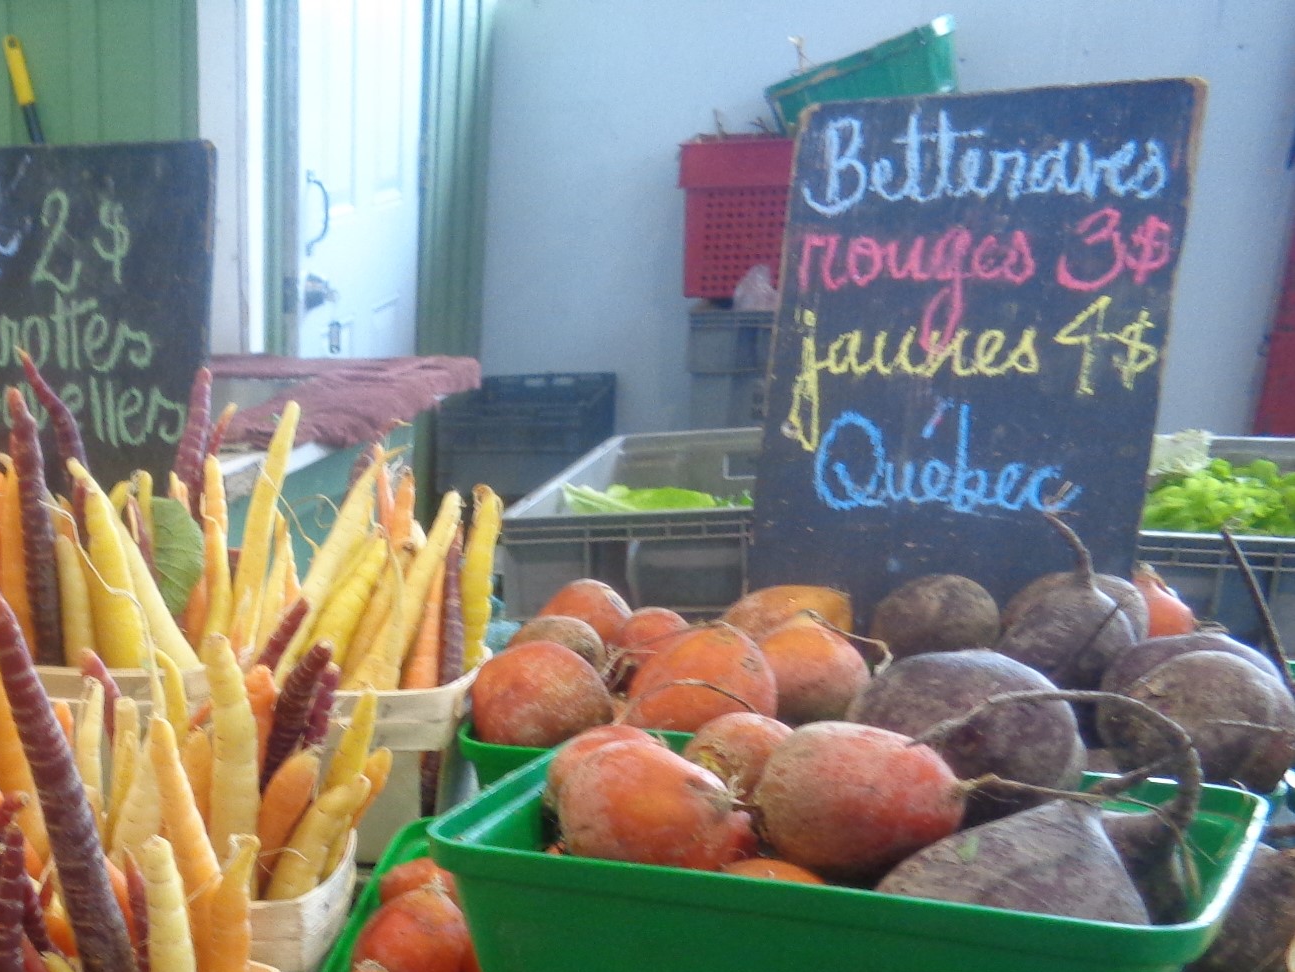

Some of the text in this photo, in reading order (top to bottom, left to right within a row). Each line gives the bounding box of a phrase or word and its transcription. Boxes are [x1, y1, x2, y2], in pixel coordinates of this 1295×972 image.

[802, 110, 1167, 218] Betteraves
[797, 206, 1172, 355] rouges 3$
[781, 295, 1159, 452] jaunes 4$
[812, 399, 1083, 516] Québec
